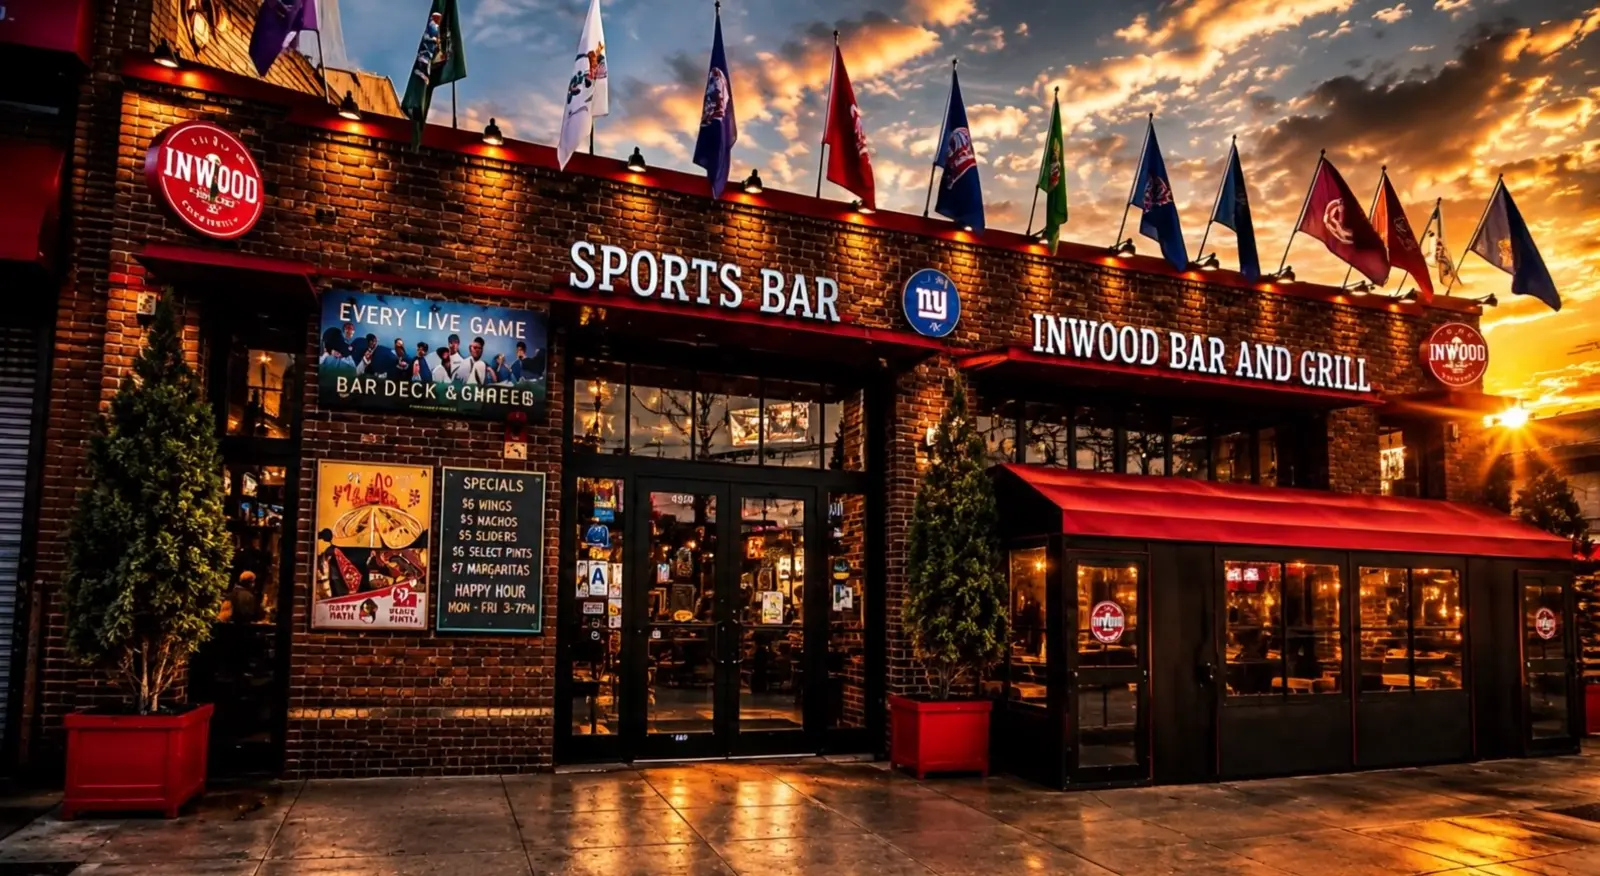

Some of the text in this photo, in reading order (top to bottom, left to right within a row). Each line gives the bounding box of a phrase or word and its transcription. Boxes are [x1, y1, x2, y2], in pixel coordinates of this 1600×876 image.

[164, 147, 258, 204] INWOOD
[569, 240, 841, 322] SPORTS BAR
[339, 302, 526, 340] EVERY LIVE GAME
[1031, 313, 1372, 392] INWOOD BAR AND GRILL
[1429, 343, 1486, 361] INWOOD
[336, 376, 377, 395] BAR
[384, 379, 437, 399] DECK
[445, 385, 457, 400] &
[463, 476, 525, 493] SPECIALS
[462, 497, 513, 512] $6 WINGS
[460, 513, 518, 528] $5 NACHOS
[458, 529, 518, 542] $5 SLIDERS
[452, 545, 533, 559] $6 SELECT PINTS
[451, 562, 531, 577] $7 MARGARITAS
[591, 567, 605, 585] A
[455, 583, 526, 599] HAPPY HOUR
[448, 601, 471, 613] MON
[480, 601, 498, 614] FRI
[503, 602, 536, 615] 3-7PM
